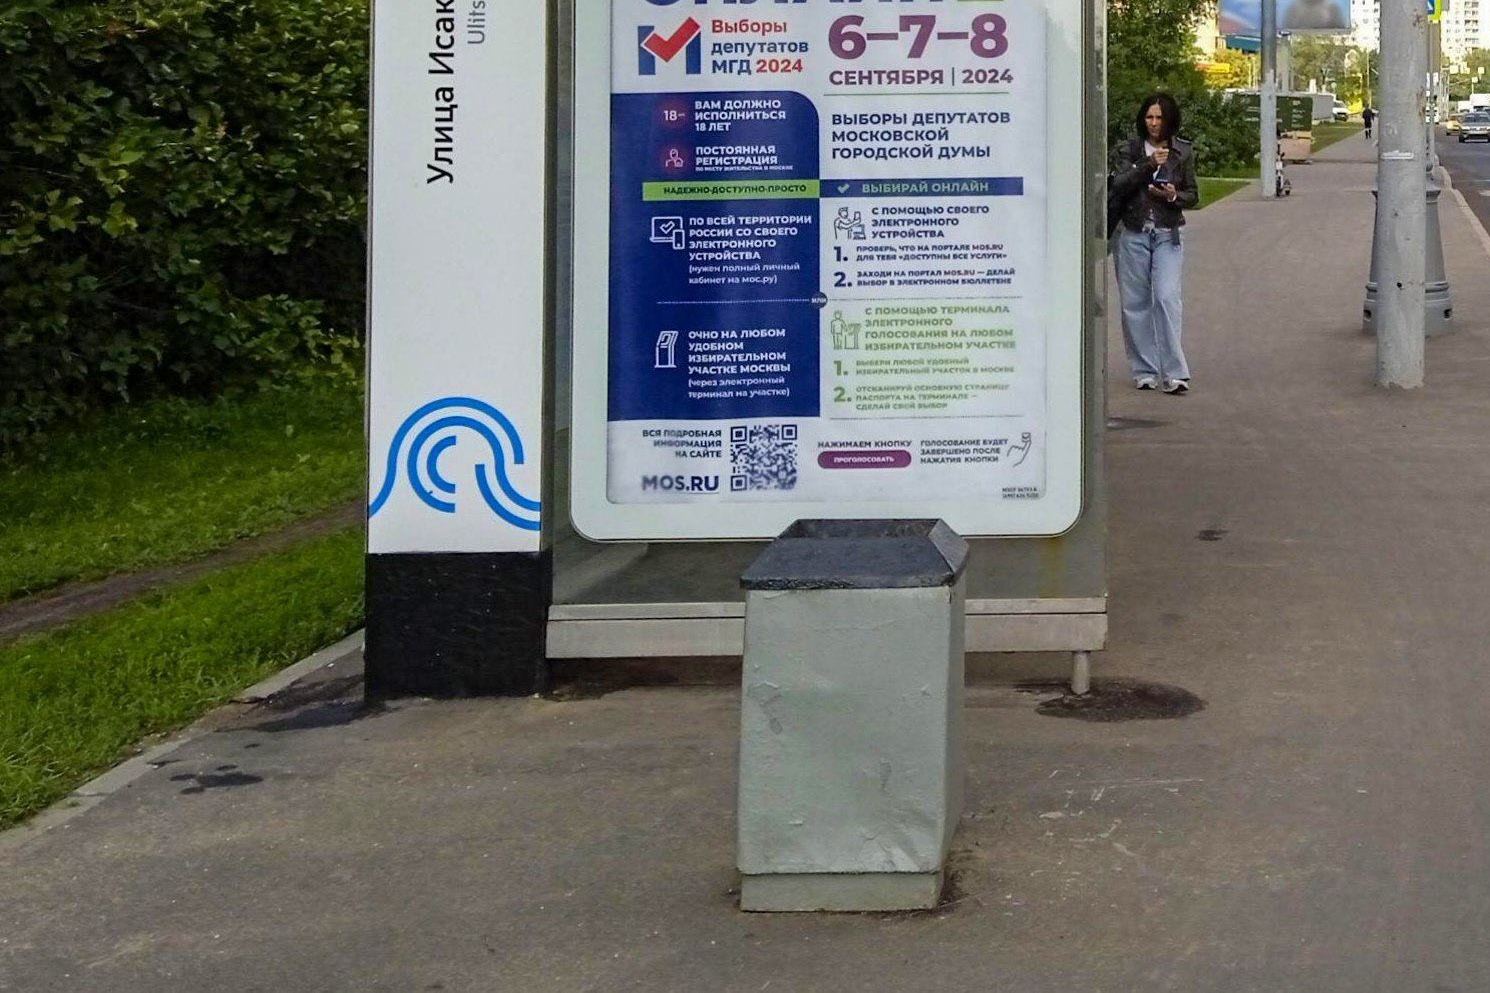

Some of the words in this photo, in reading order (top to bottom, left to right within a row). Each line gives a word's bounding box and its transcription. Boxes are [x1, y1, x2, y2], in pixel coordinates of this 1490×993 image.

[712, 19, 787, 36] Выборы
[711, 40, 809, 54] депутатов
[712, 59, 752, 75] МГД
[756, 58, 803, 73] 2024
[829, 69, 944, 85] СЕНТЯБРЯ
[962, 69, 1014, 83] 2024
[695, 101, 721, 109] ВАМ
[724, 100, 781, 110] ДОЛЖНО
[695, 110, 786, 121] ИСПОЛНИТЬСЯ
[832, 113, 907, 126] ВЫБОРЫ
[912, 112, 1011, 126] ДЕПУТАТОВ
[696, 123, 706, 132] 18
[708, 122, 730, 131] ЛЕТ
[427, 85, 458, 184] Улица
[832, 127, 949, 143] МОСКОВСКОЙ
[696, 146, 775, 155] ПОСТОЯННАЯ
[832, 144, 933, 160] ГОРОДСКОЙ
[938, 146, 990, 159] ДУМЫ
[696, 156, 777, 166] РЕГИСТРАЦИЯ
[862, 180, 928, 193] ВЫБИРАЙ
[932, 179, 989, 192] ОНЛАЙН
[872, 207, 879, 215] С
[882, 206, 944, 215] ПОМОЩЬЮ
[947, 206, 989, 214] СВОЕГО
[689, 217, 704, 226] ПО
[706, 215, 735, 225] ВСЕЙ
[738, 216, 812, 225] ТЕРРИТОРИИ
[872, 218, 959, 227] ЭЛЕКТРОННОГО
[689, 228, 733, 237] РОССИИ
[736, 228, 751, 236] СО
[754, 227, 798, 236] СВОЕГО
[872, 228, 944, 239] УСТРОЙСТВА
[689, 239, 776, 249] ЭЛЕКТРОННОГО
[689, 250, 761, 261] УСТРОЙСТВА
[834, 246, 848, 262] 1.
[689, 265, 720, 274] (нужен
[722, 263, 760, 272] полный
[762, 262, 800, 272] личный
[857, 270, 891, 278] ЗАХОДИ
[689, 276, 725, 285] кабинет
[833, 272, 852, 287] 2.
[865, 307, 872, 315] С
[875, 306, 937, 316] ПОМОЩЬЮ
[941, 306, 1010, 314] ТЕРМИНАЛА
[865, 318, 952, 327] ЭЛЕКТРОННОГО
[688, 330, 719, 339] ОЧНО
[721, 330, 738, 339] НА
[741, 329, 785, 338] ЛЮБОМ
[865, 330, 948, 339] ГОЛОСОВАНИЯ
[951, 330, 967, 338] НА
[970, 329, 1014, 338] ЛЮБОМ
[688, 342, 743, 352] УДОБНОМ
[865, 341, 963, 351] ИЗБИРАТЕЛЬНОМ
[966, 341, 1016, 349] УЧАСТКЕ
[688, 353, 786, 363] ИЗБИРАТЕЛЬНОМ
[688, 365, 737, 375] УЧАСТКЕ
[740, 364, 790, 374] МОСКВЫ
[833, 360, 848, 376] 1.
[688, 378, 717, 387] (через
[719, 376, 785, 386] электронный
[688, 389, 733, 398] терминал
[750, 388, 790, 398] участке)
[833, 387, 852, 402] 2.
[664, 430, 721, 438] ПОДРОБНАЯ
[654, 440, 721, 448] ИНФОРМАЦИЯ
[874, 440, 912, 448] КНОПКУ
[921, 439, 981, 447] ГОЛОСОВАНИЕ
[675, 450, 687, 458] НА
[689, 449, 721, 458] САЙТЕ
[642, 476, 719, 491] MOS.RU
